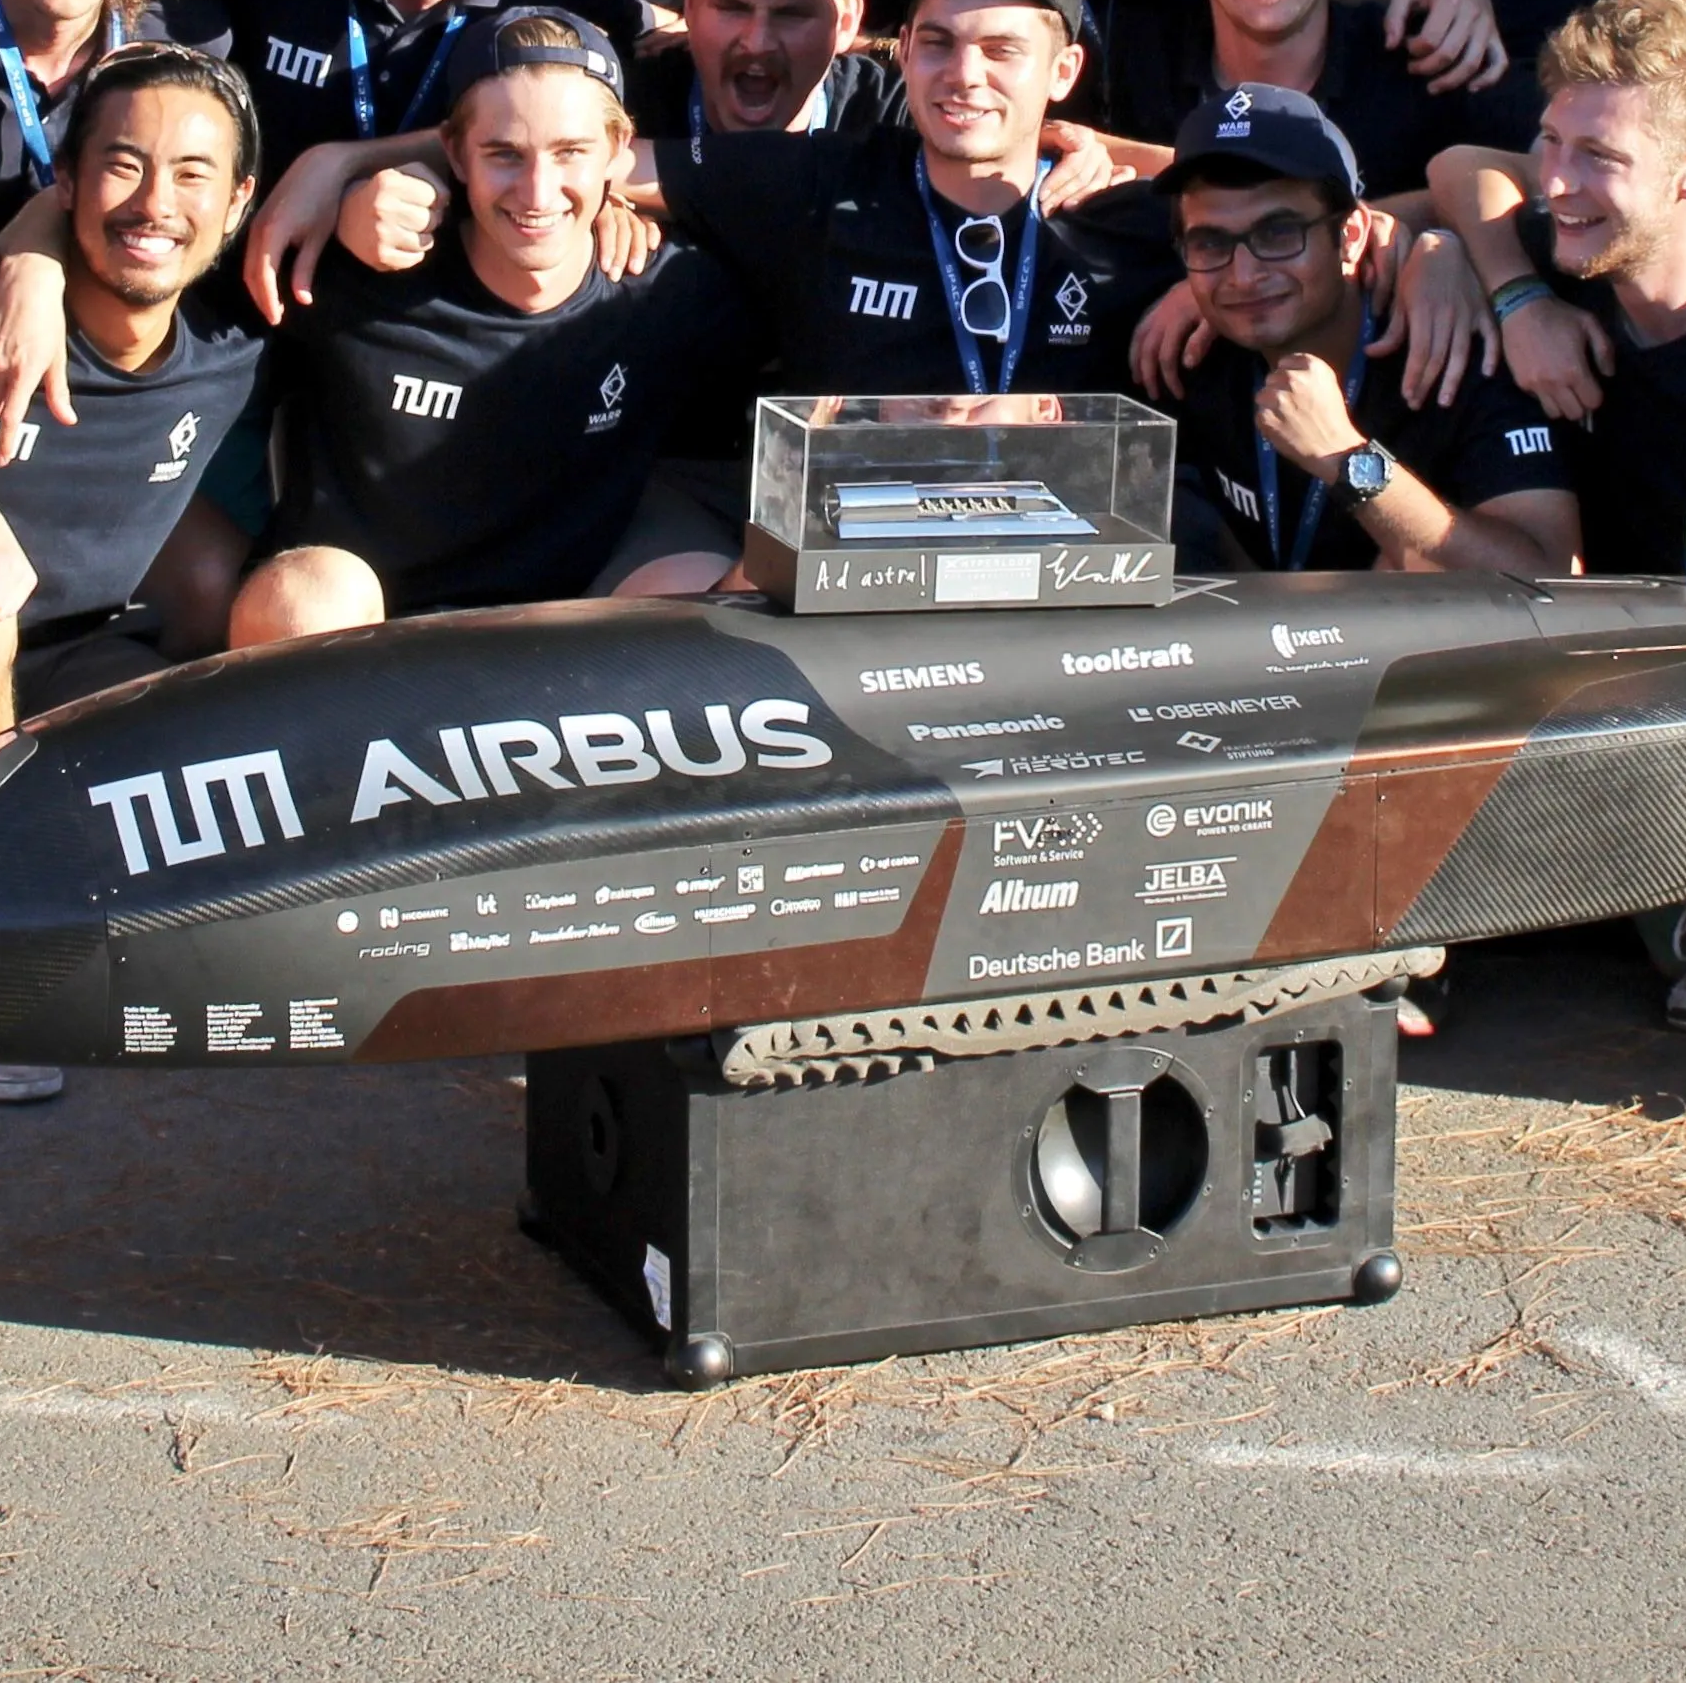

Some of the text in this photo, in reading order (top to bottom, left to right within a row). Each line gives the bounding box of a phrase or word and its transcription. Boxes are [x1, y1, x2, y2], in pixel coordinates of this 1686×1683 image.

[264, 35, 333, 88] TUM
[12, 69, 34, 127] SPACEX
[1218, 119, 1252, 131] WARR
[1017, 255, 1032, 310] SPACEX
[850, 276, 919, 321] TUM
[1050, 323, 1092, 336] WARR
[392, 373, 463, 420] TUM
[588, 408, 623, 425] WARR
[1504, 426, 1553, 456] TUM
[815, 554, 928, 598] Ad astra!
[859, 661, 985, 694] SIEMENS
[1156, 694, 1302, 721] OBERMEYER
[906, 713, 1066, 742] Panasonic
[350, 699, 835, 824] AIRBUS
[1011, 751, 1147, 776] AEROTEC
[89, 749, 305, 874] TUM
[1184, 799, 1274, 828] EVONIK
[1196, 820, 1274, 837] POWER TO CREATE
[993, 848, 1085, 868] Software & Service
[1144, 862, 1227, 892] JELBA
[978, 879, 1080, 915] Altium
[968, 937, 1146, 981] Deutsche Bank
